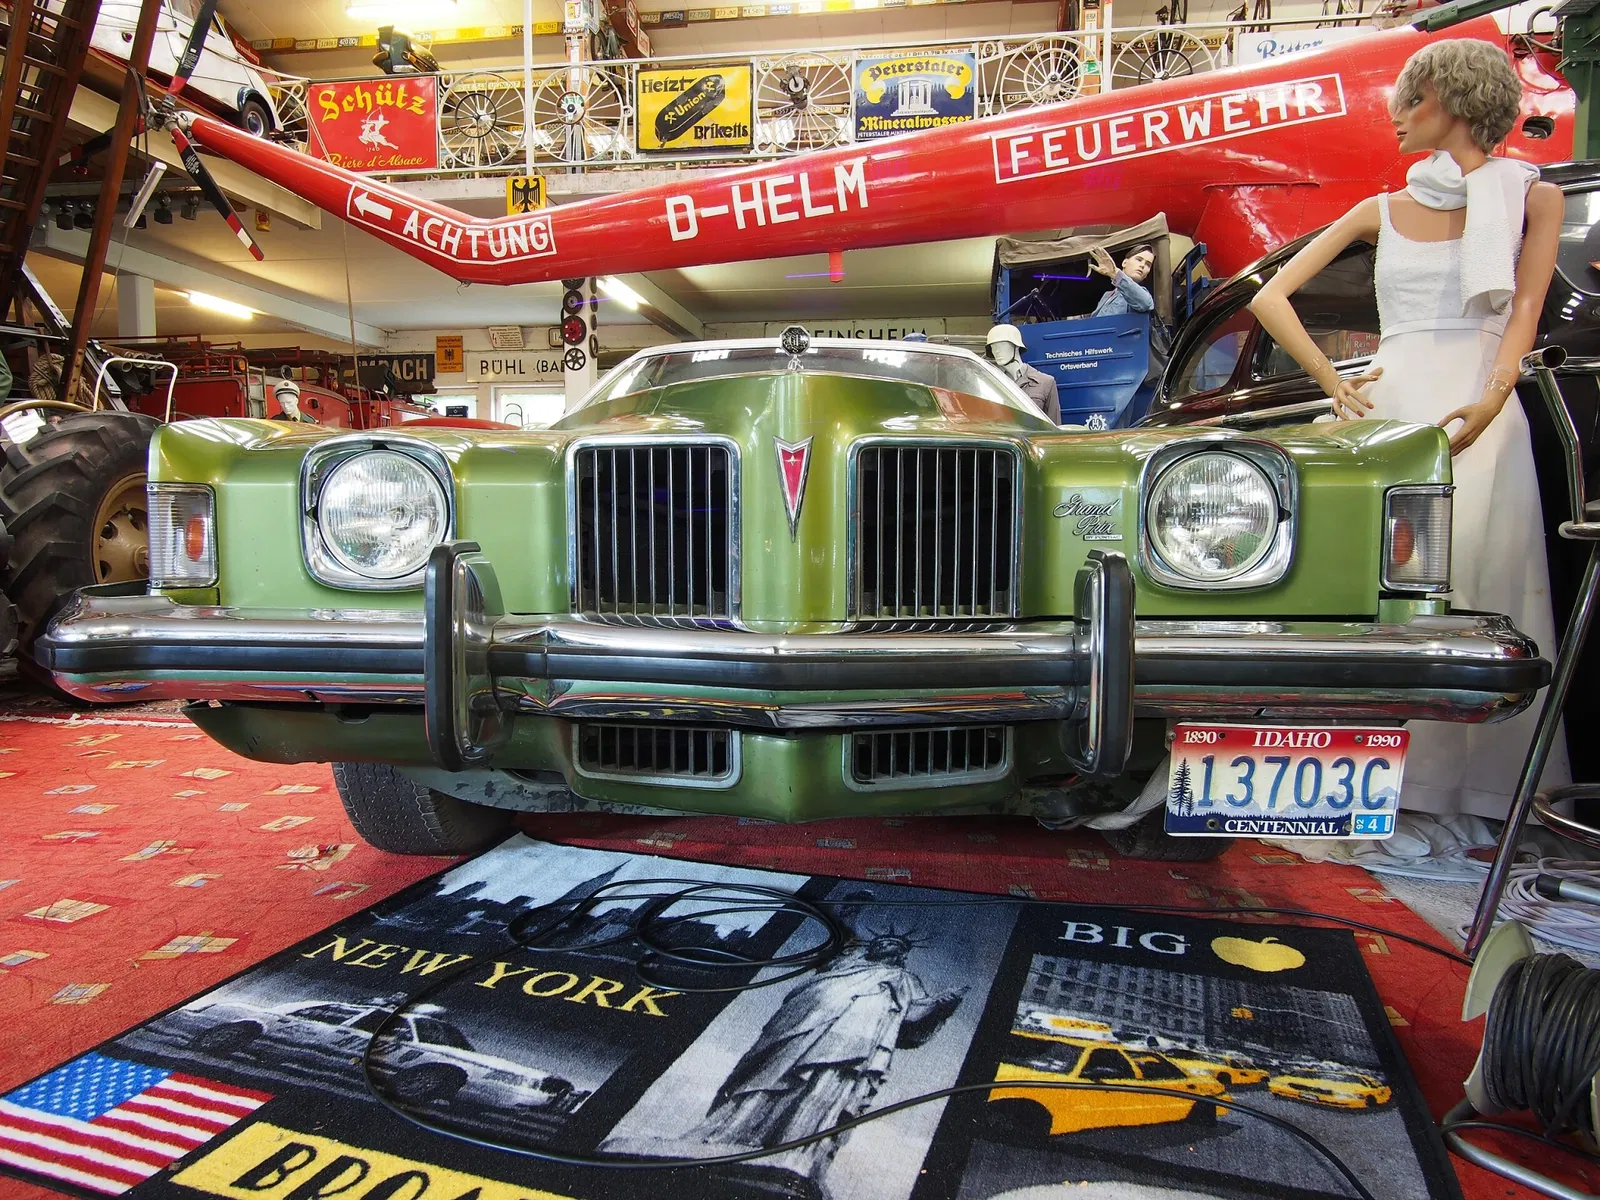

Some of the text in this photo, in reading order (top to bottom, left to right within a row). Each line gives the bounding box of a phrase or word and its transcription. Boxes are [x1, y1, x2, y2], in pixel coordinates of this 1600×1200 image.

[869, 59, 965, 81] Peterstaler
[642, 76, 698, 93] Heizt
[319, 82, 426, 123] Schütz
[674, 90, 706, 116] Union
[693, 122, 749, 140] Briketts
[859, 115, 973, 131] Mineralwasser
[1009, 82, 1326, 175] FEUERWEHR
[665, 157, 869, 242] D-HELM
[402, 210, 550, 258] ACHTUNG
[1045, 347, 1113, 359] Technisches Hilfswerk
[480, 359, 526, 376] BÜHL
[1060, 361, 1098, 371] Ortsverband
[1053, 494, 1121, 518] Grand
[1072, 515, 1116, 536] Prix
[1183, 730, 1401, 749] 1890 IDAHO 1990
[1197, 755, 1390, 810] 13703C
[1224, 819, 1339, 835] CENTENNIAL
[1355, 818, 1378, 832] 92 4
[1057, 920, 1191, 956] BIG
[302, 934, 687, 1018] NEW YORK
[230, 1141, 484, 1200] BRO
